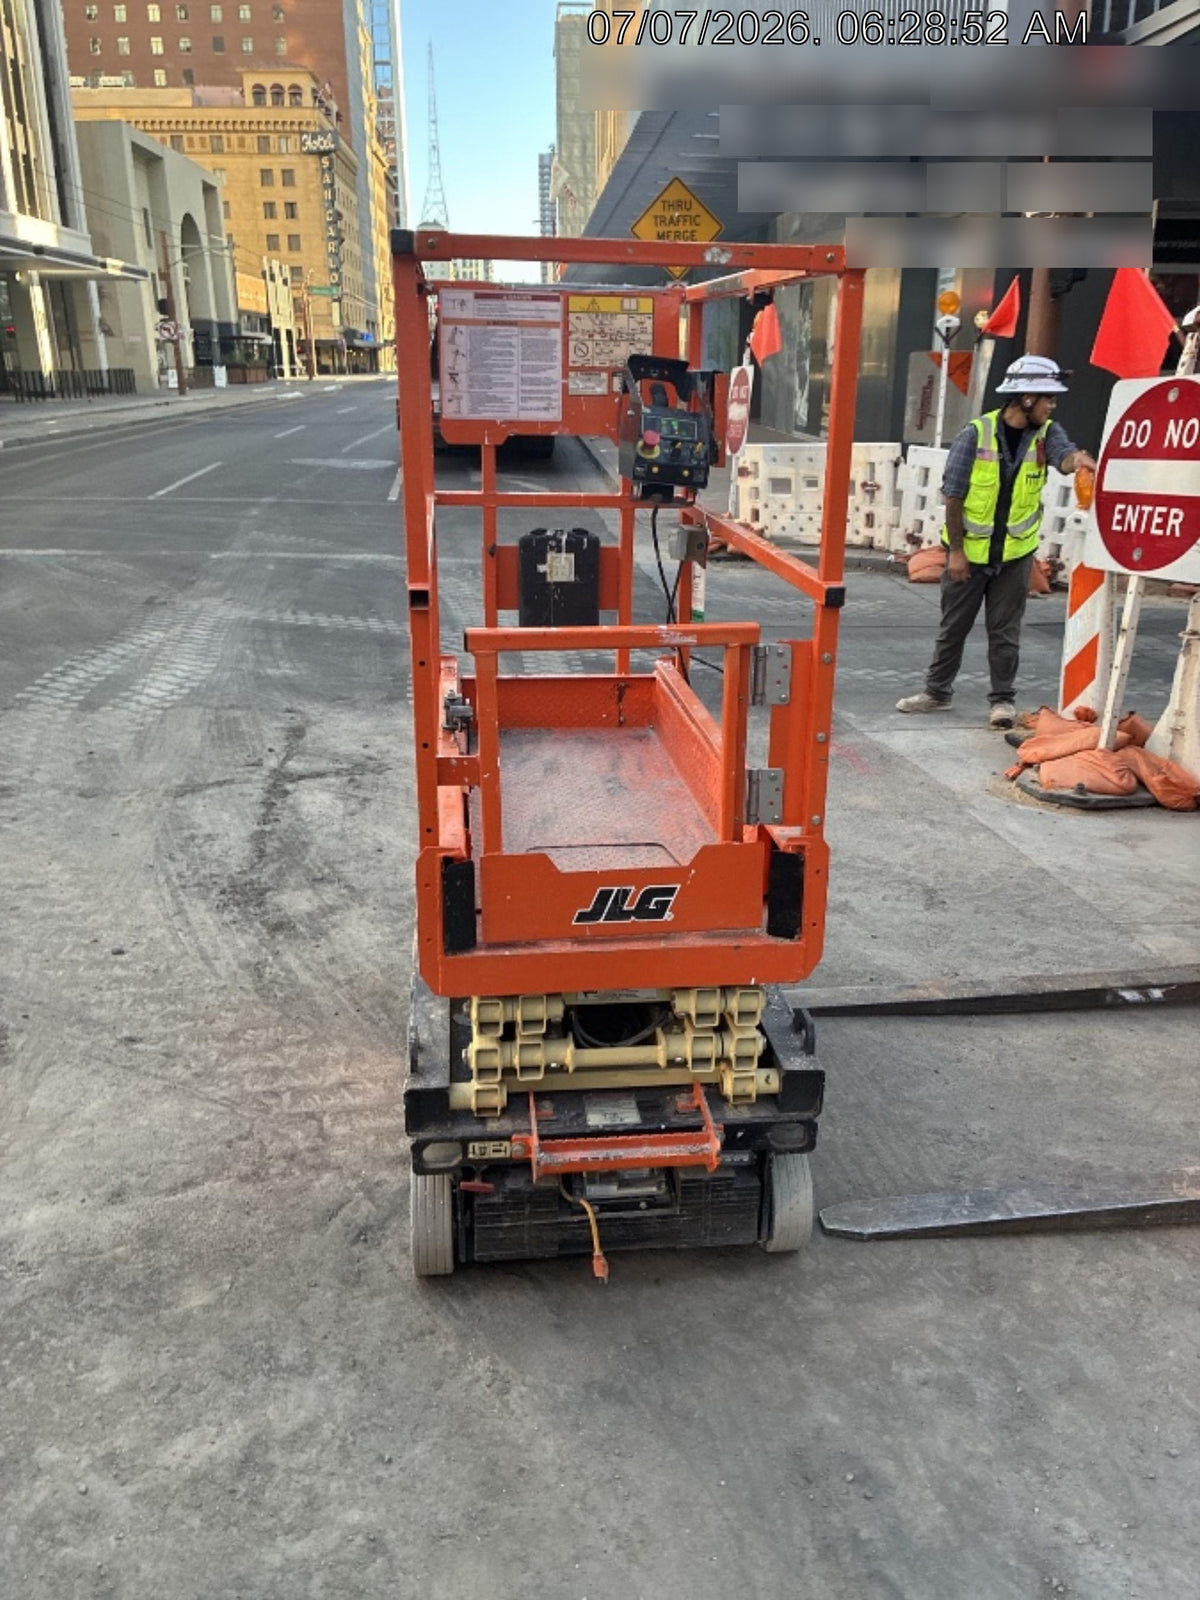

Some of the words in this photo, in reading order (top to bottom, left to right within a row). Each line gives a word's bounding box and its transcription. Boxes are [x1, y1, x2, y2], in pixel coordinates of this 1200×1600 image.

[301, 132, 336, 152] Hotel
[661, 199, 693, 212] THRU
[653, 214, 702, 227] TRAFFIC
[656, 229, 697, 241] MERGE
[1120, 419, 1151, 448] DO
[1163, 417, 1200, 449] NO
[1111, 503, 1184, 537] ENTER
[572, 884, 681, 925] JLG
